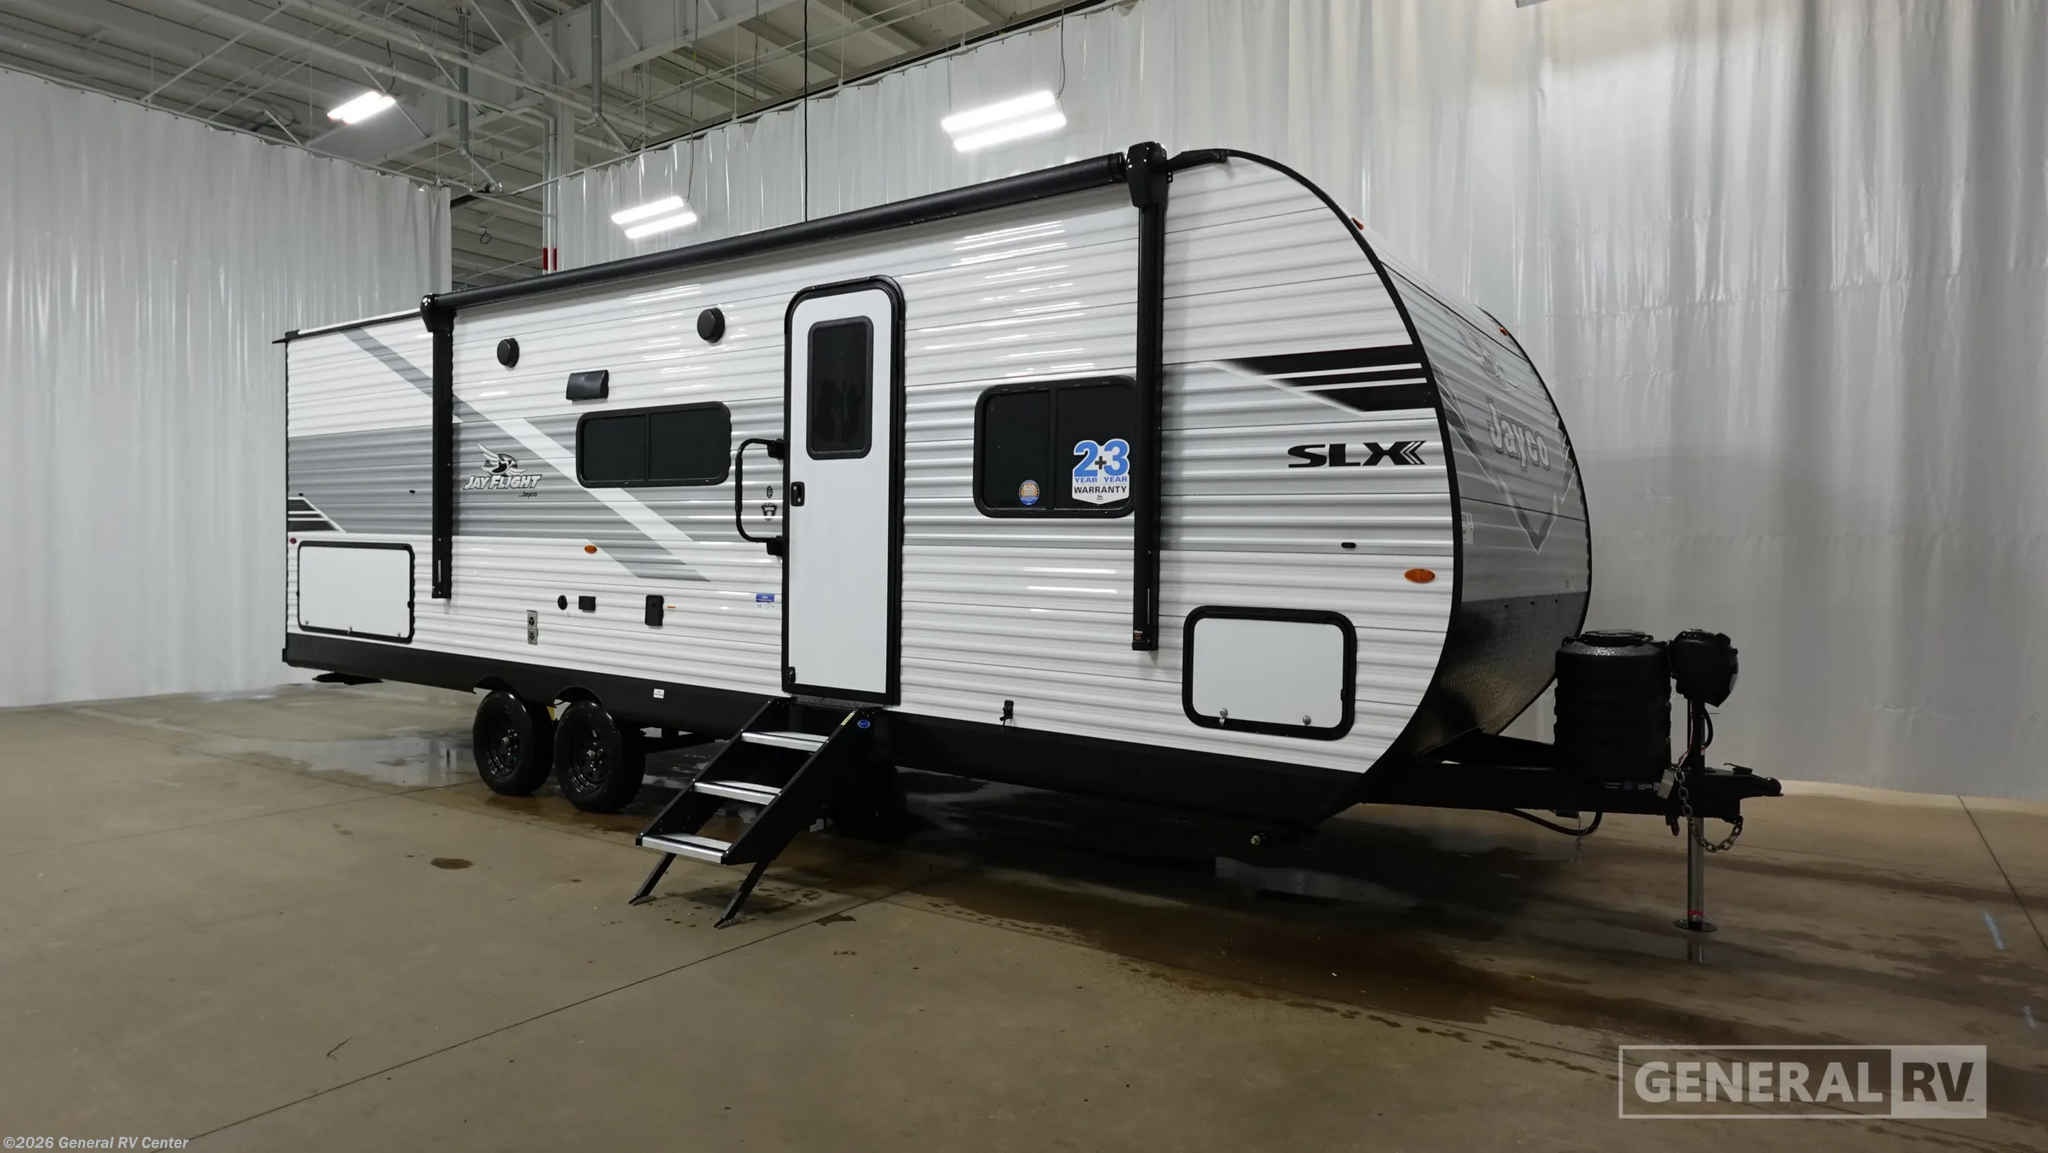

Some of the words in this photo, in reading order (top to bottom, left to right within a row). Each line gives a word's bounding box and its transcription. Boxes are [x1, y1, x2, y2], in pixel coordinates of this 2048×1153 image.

[1486, 396, 1551, 472] Jayco
[1288, 440, 1427, 468] SLX
[463, 474, 490, 490] JAY
[489, 474, 543, 490] FLIGHT
[1074, 486, 1127, 494] WARRANTY
[521, 491, 538, 499] Jayco
